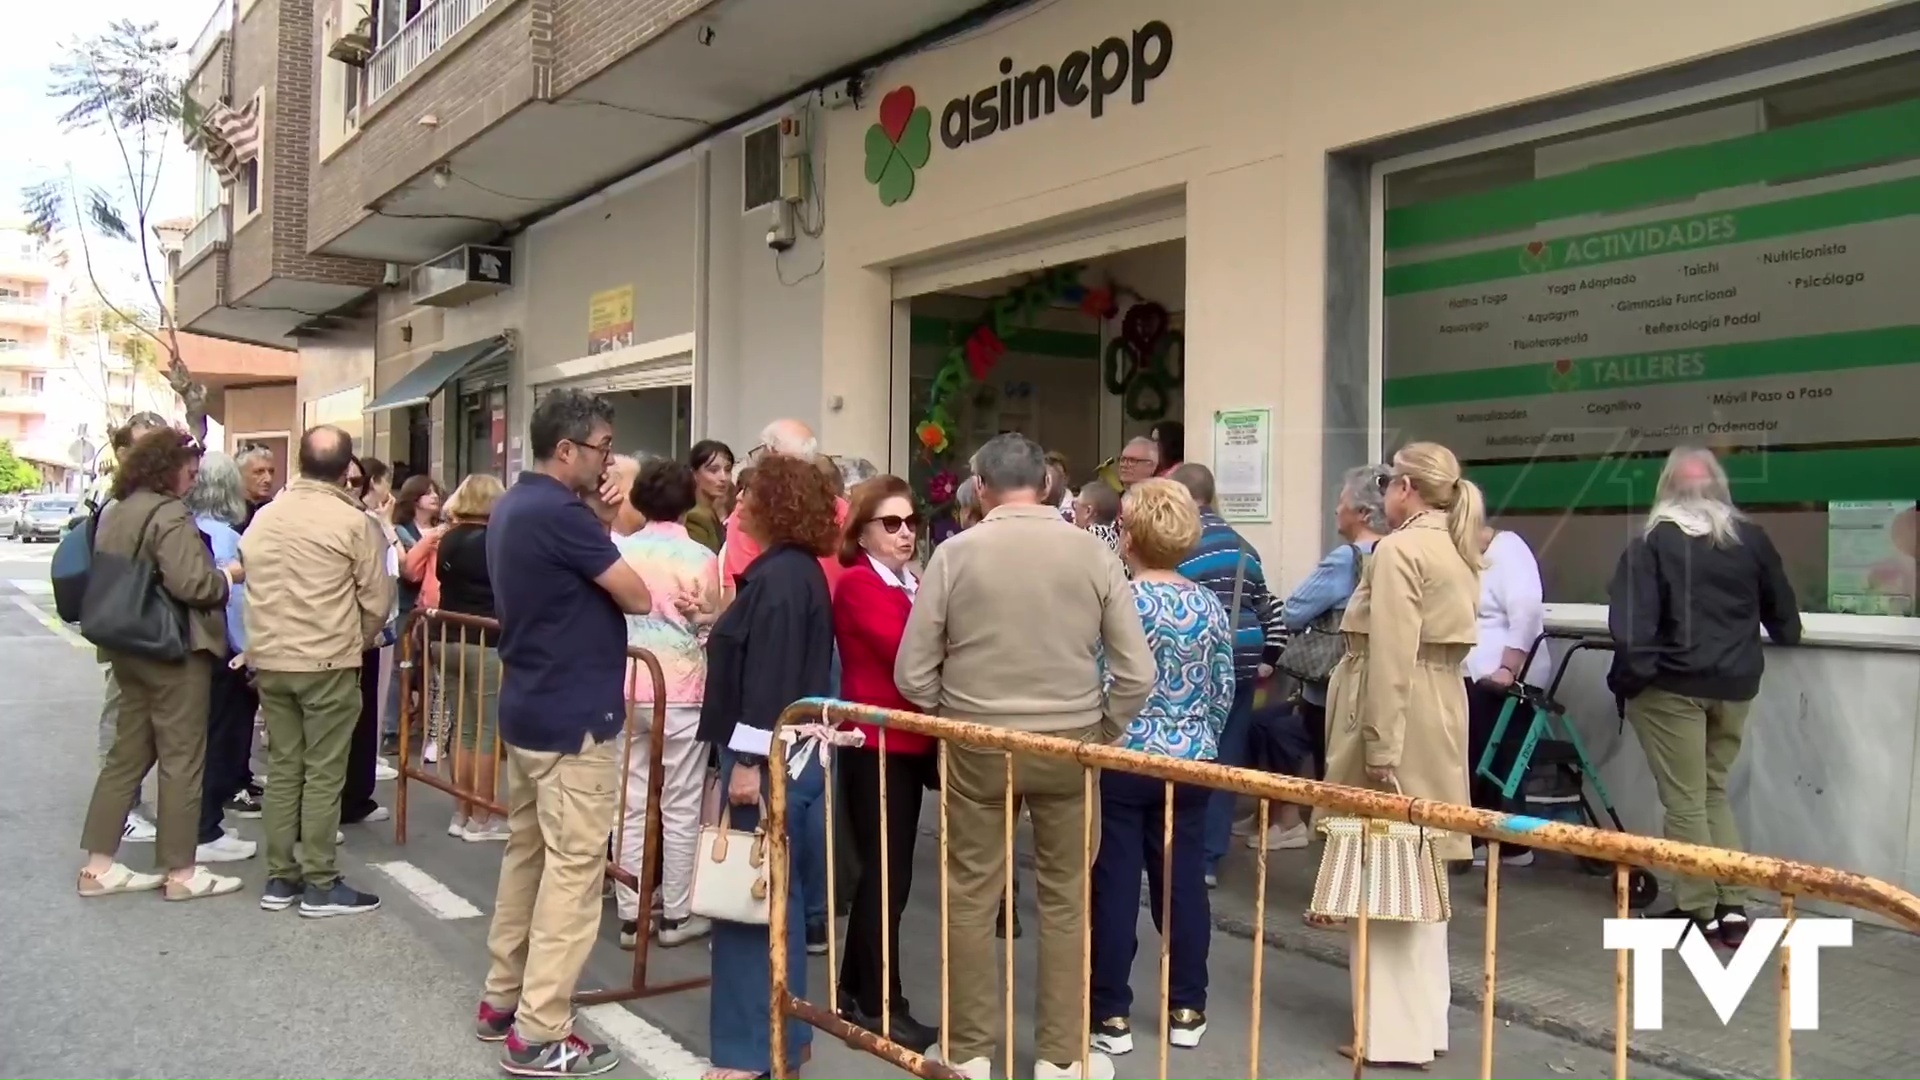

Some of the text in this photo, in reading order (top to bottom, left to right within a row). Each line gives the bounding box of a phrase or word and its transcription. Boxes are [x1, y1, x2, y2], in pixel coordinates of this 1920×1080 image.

[940, 20, 1173, 149] asimepp
[1564, 214, 1737, 263] ACTIVIDADES
[1763, 243, 1847, 264] Nutricionista
[1684, 262, 1719, 277] Taichi
[1547, 274, 1636, 295] Yoga Adaptado
[1795, 272, 1865, 290] Psicóloga
[1617, 286, 1737, 312] Gimnasia Funcional
[1527, 309, 1579, 324] Aquagym
[1724, 312, 1761, 326] Podal
[1592, 353, 1705, 383] TALLERES
[1713, 387, 1833, 405] Móvil Paso a Paso
[1707, 419, 1778, 434] Ordenador
